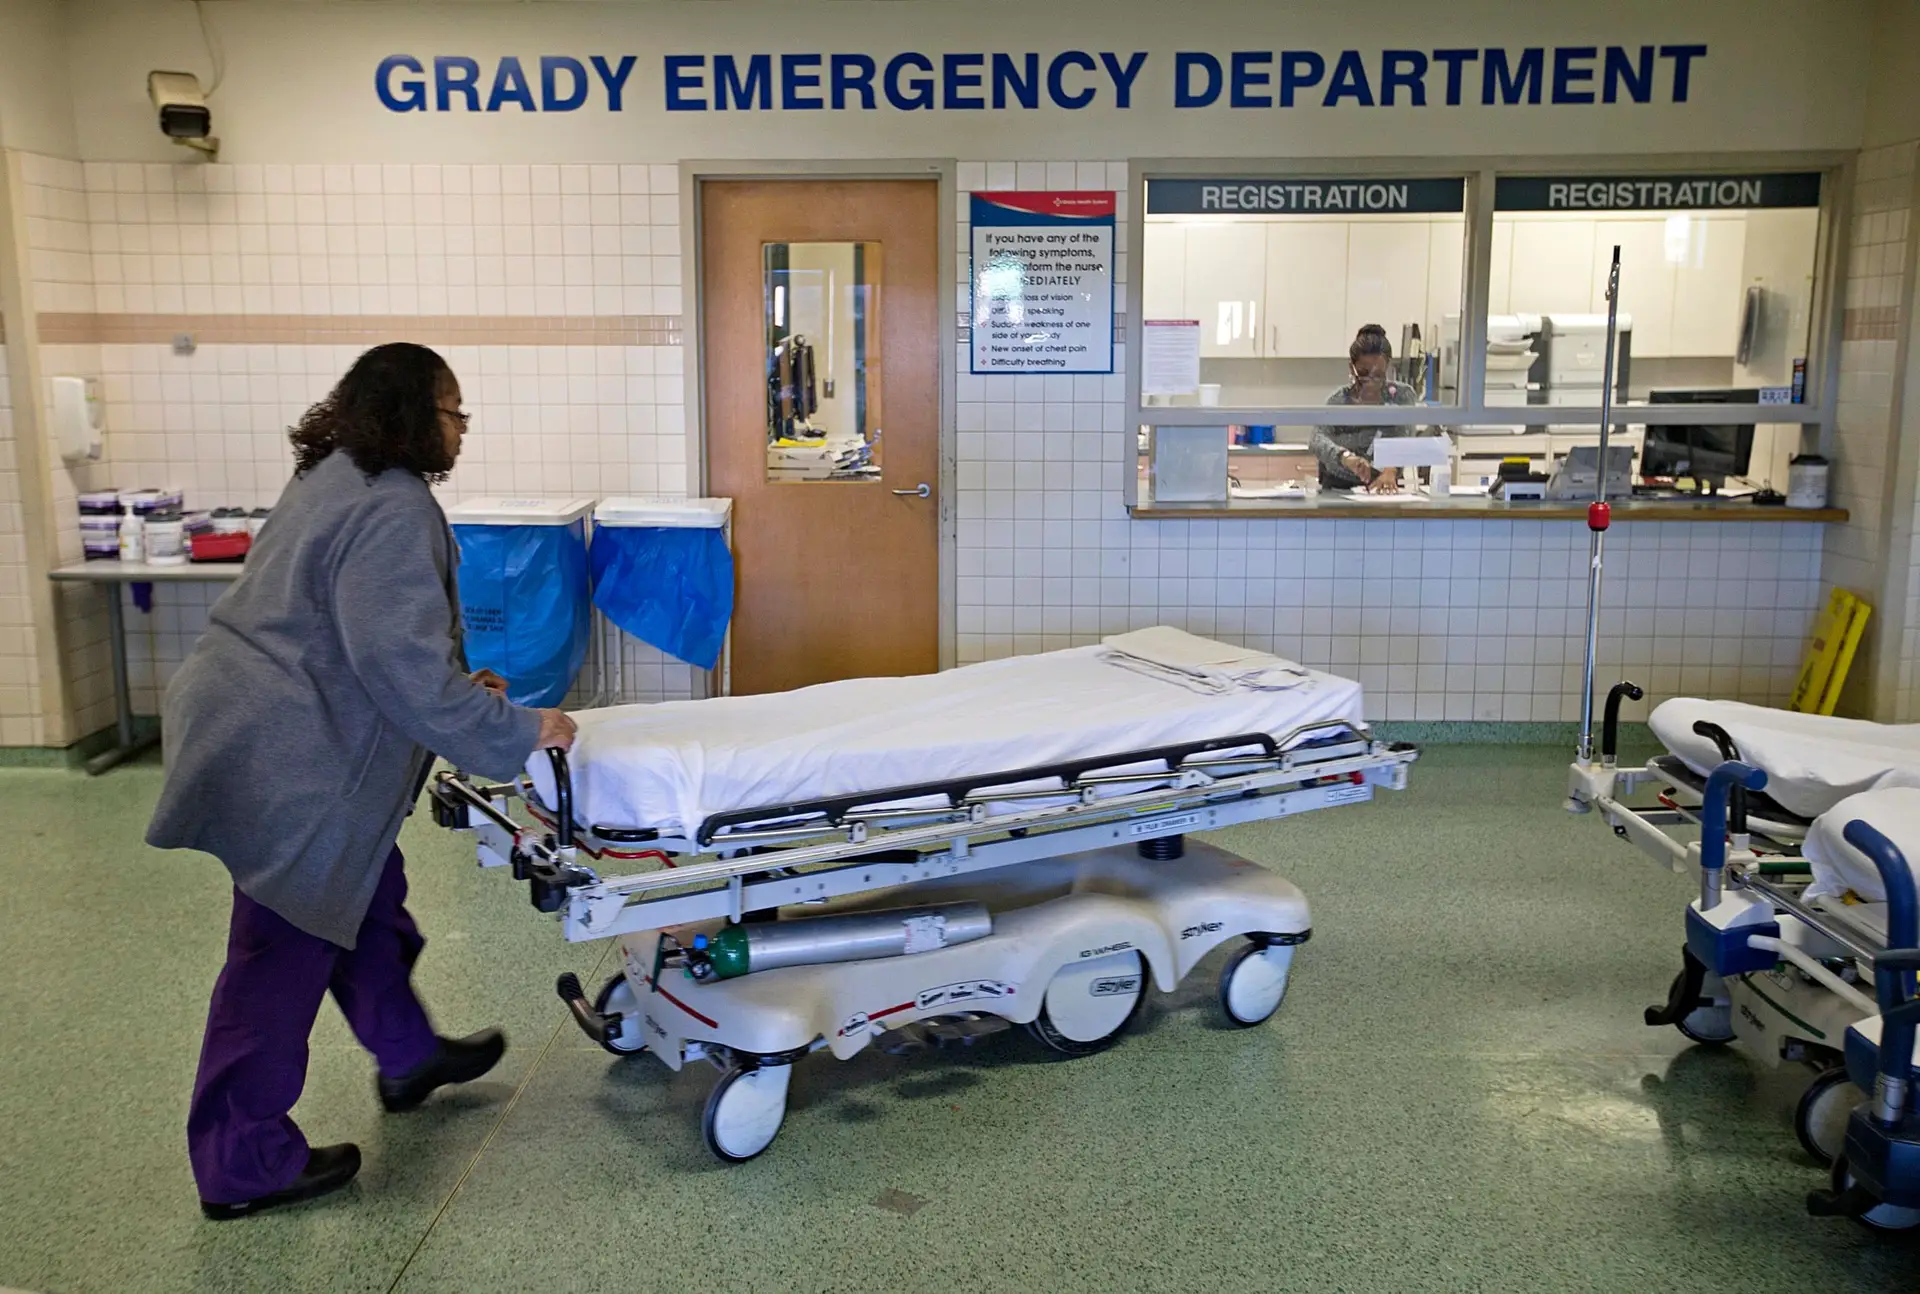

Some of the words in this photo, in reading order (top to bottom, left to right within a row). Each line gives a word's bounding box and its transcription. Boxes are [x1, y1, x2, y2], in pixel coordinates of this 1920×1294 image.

[376, 54, 636, 113] GRADY
[665, 52, 1148, 113] EMERGENCY
[1174, 46, 1707, 109] DEPARTMENT
[1201, 185, 1409, 209] REGISTRATION
[1549, 181, 1762, 207] REGISTRATION
[985, 232, 993, 243] If
[994, 234, 1015, 245] you
[1017, 232, 1044, 243] have
[1046, 234, 1067, 245] any
[1069, 232, 1080, 243] of
[1082, 232, 1100, 243] the
[1039, 248, 1095, 259] symptoms,
[1020, 262, 1053, 272] nform
[1055, 262, 1072, 272] the
[1074, 263, 1103, 272] nurse
[1024, 293, 1039, 301] loss
[1040, 293, 1049, 301] of
[1050, 293, 1074, 301] vision
[1027, 307, 1065, 316] speaking
[1024, 320, 1064, 329] weakness
[1065, 320, 1074, 329] of
[1075, 321, 1091, 329] one
[991, 331, 1008, 340] side
[1009, 331, 1018, 340] of
[991, 345, 1010, 354] New
[1011, 345, 1033, 354] onset
[1034, 345, 1043, 354] of
[1044, 345, 1067, 354] chest
[1068, 346, 1087, 355] pain
[991, 358, 1025, 368] Difficulty
[1027, 358, 1066, 368] breathing
